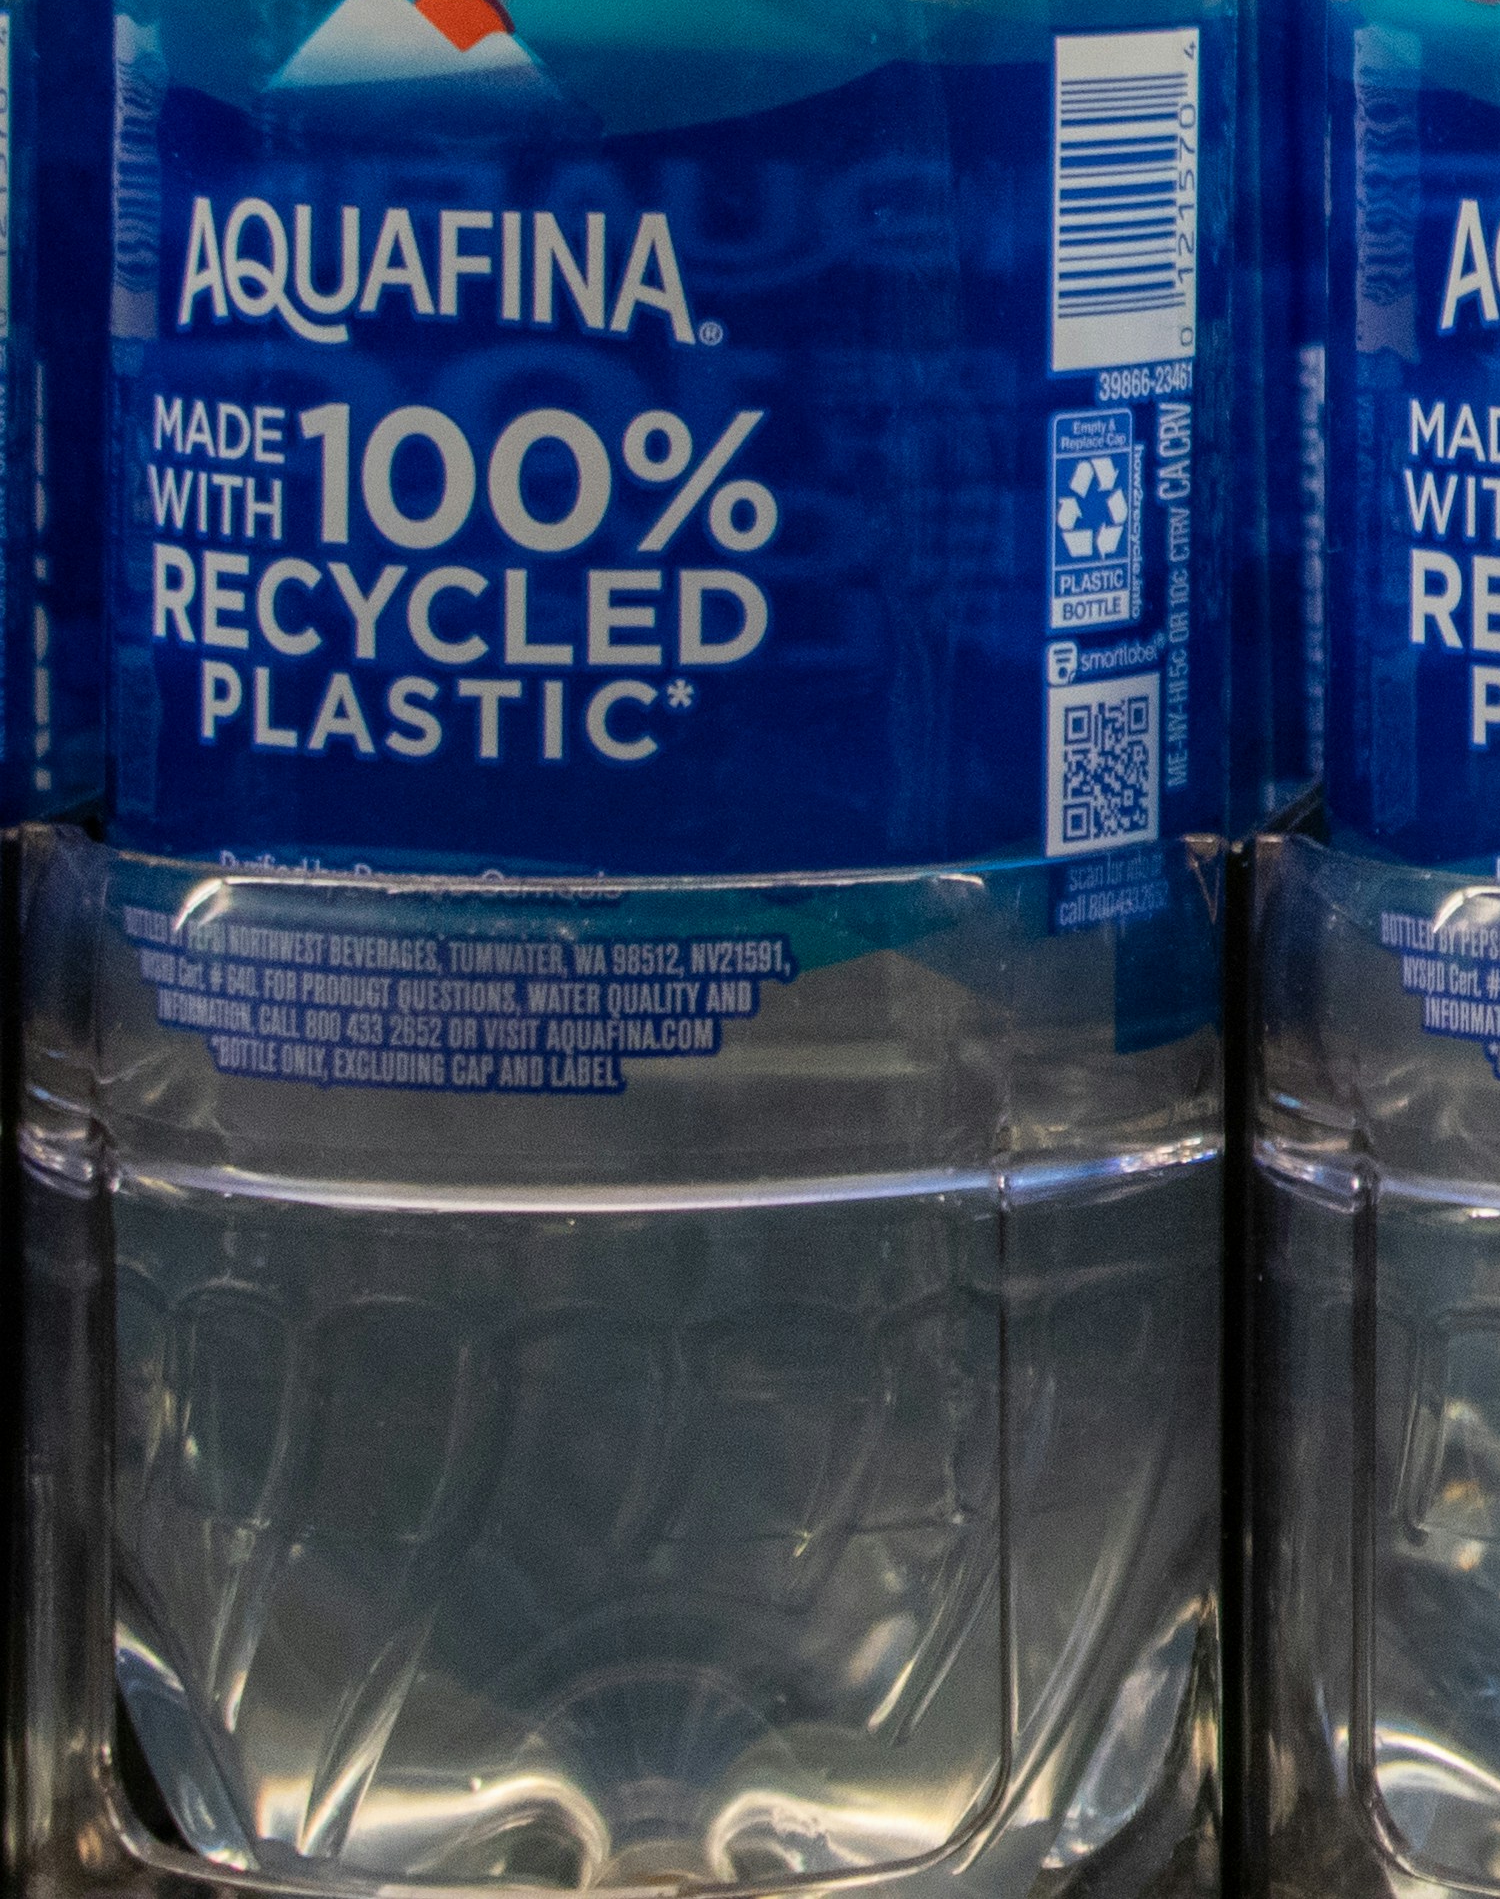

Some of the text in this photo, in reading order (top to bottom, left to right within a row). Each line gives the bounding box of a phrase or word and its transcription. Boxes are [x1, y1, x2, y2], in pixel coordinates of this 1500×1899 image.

[1099, 362, 1193, 401] 39866-23461
[154, 396, 284, 463] MADE
[1158, 401, 1192, 458] CRV
[299, 403, 776, 551] 100%
[1158, 458, 1191, 501] CA
[149, 466, 281, 539] WITH
[1060, 569, 1125, 595] PLASTIC
[153, 540, 766, 666] RECYCLED
[1062, 595, 1122, 621] BOTTLE
[705, 981, 752, 1013] AND
[484, 1017, 542, 1050] VISIT
[498, 1056, 543, 1087] AND
[551, 1054, 619, 1088] LABEL
